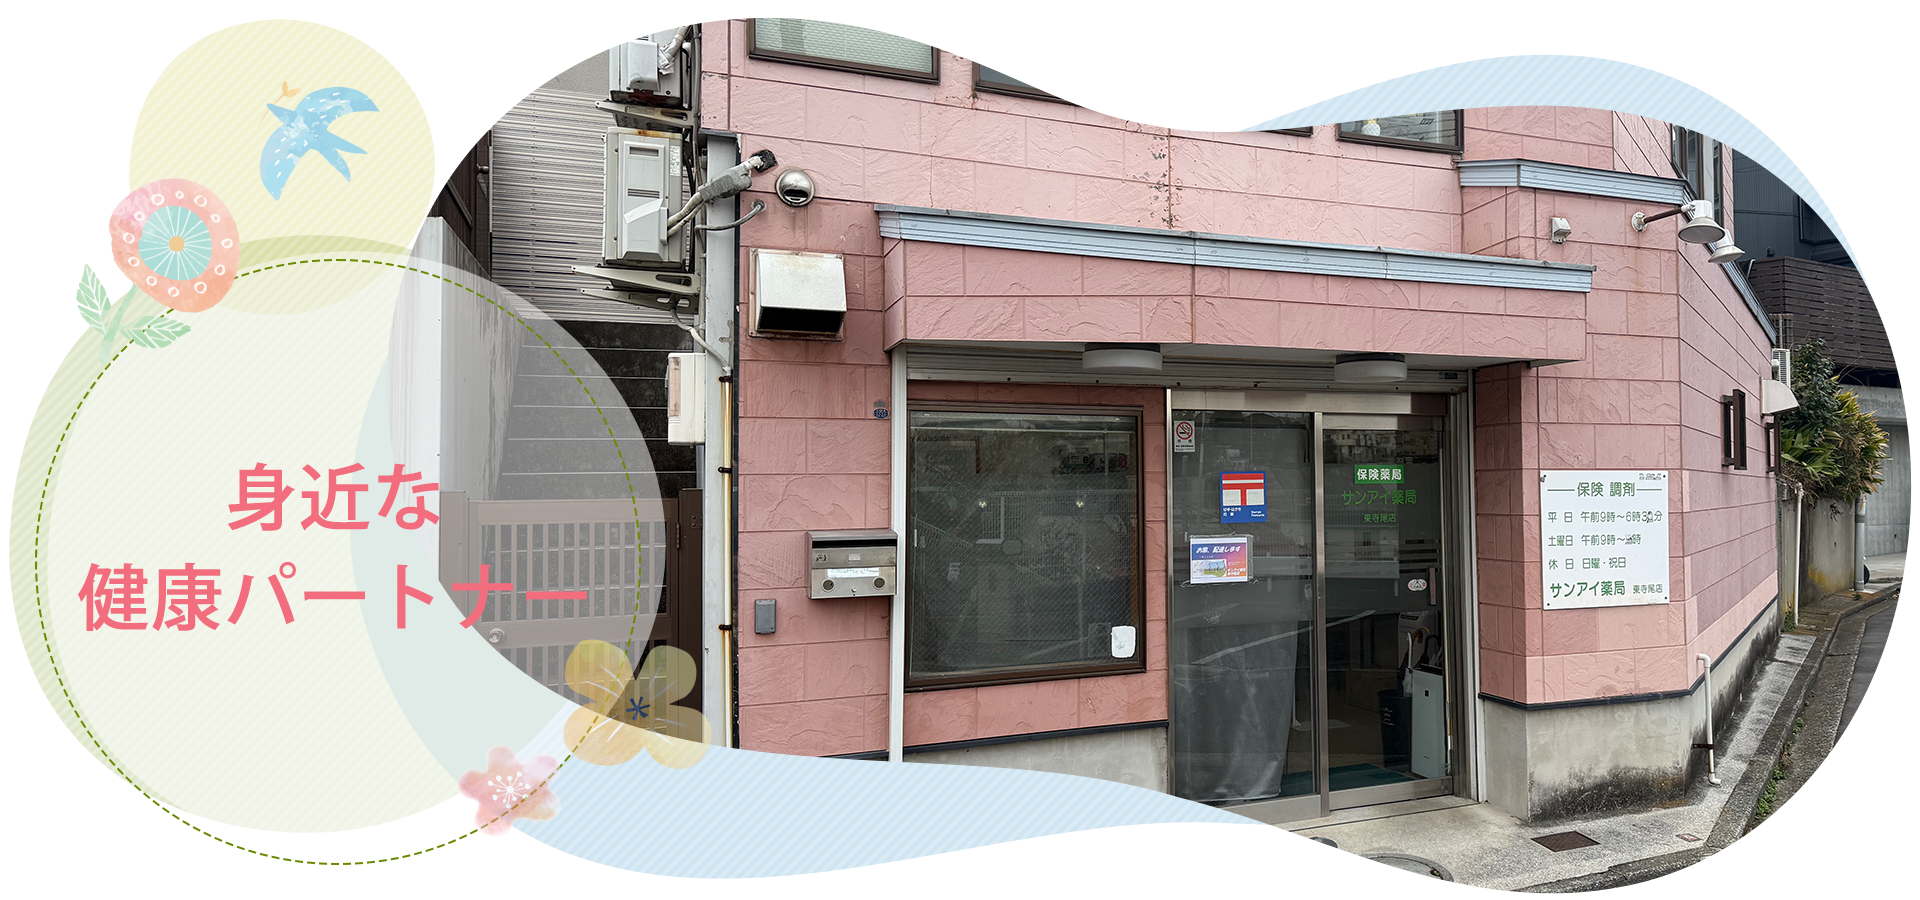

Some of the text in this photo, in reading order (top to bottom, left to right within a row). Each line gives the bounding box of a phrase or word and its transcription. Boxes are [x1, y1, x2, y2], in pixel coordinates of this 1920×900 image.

[1357, 468, 1402, 481] 保険薬局
[1577, 482, 1635, 497] 保険 調剤
[1342, 489, 1417, 506] サンアイ薬局
[1363, 513, 1397, 523] 東寺尾店
[1548, 533, 1641, 547] 土曜日 午前9時～時
[1582, 556, 1626, 570] 日曜・祝日
[1549, 580, 1664, 599] サンアイ薬局 東寺尾店
